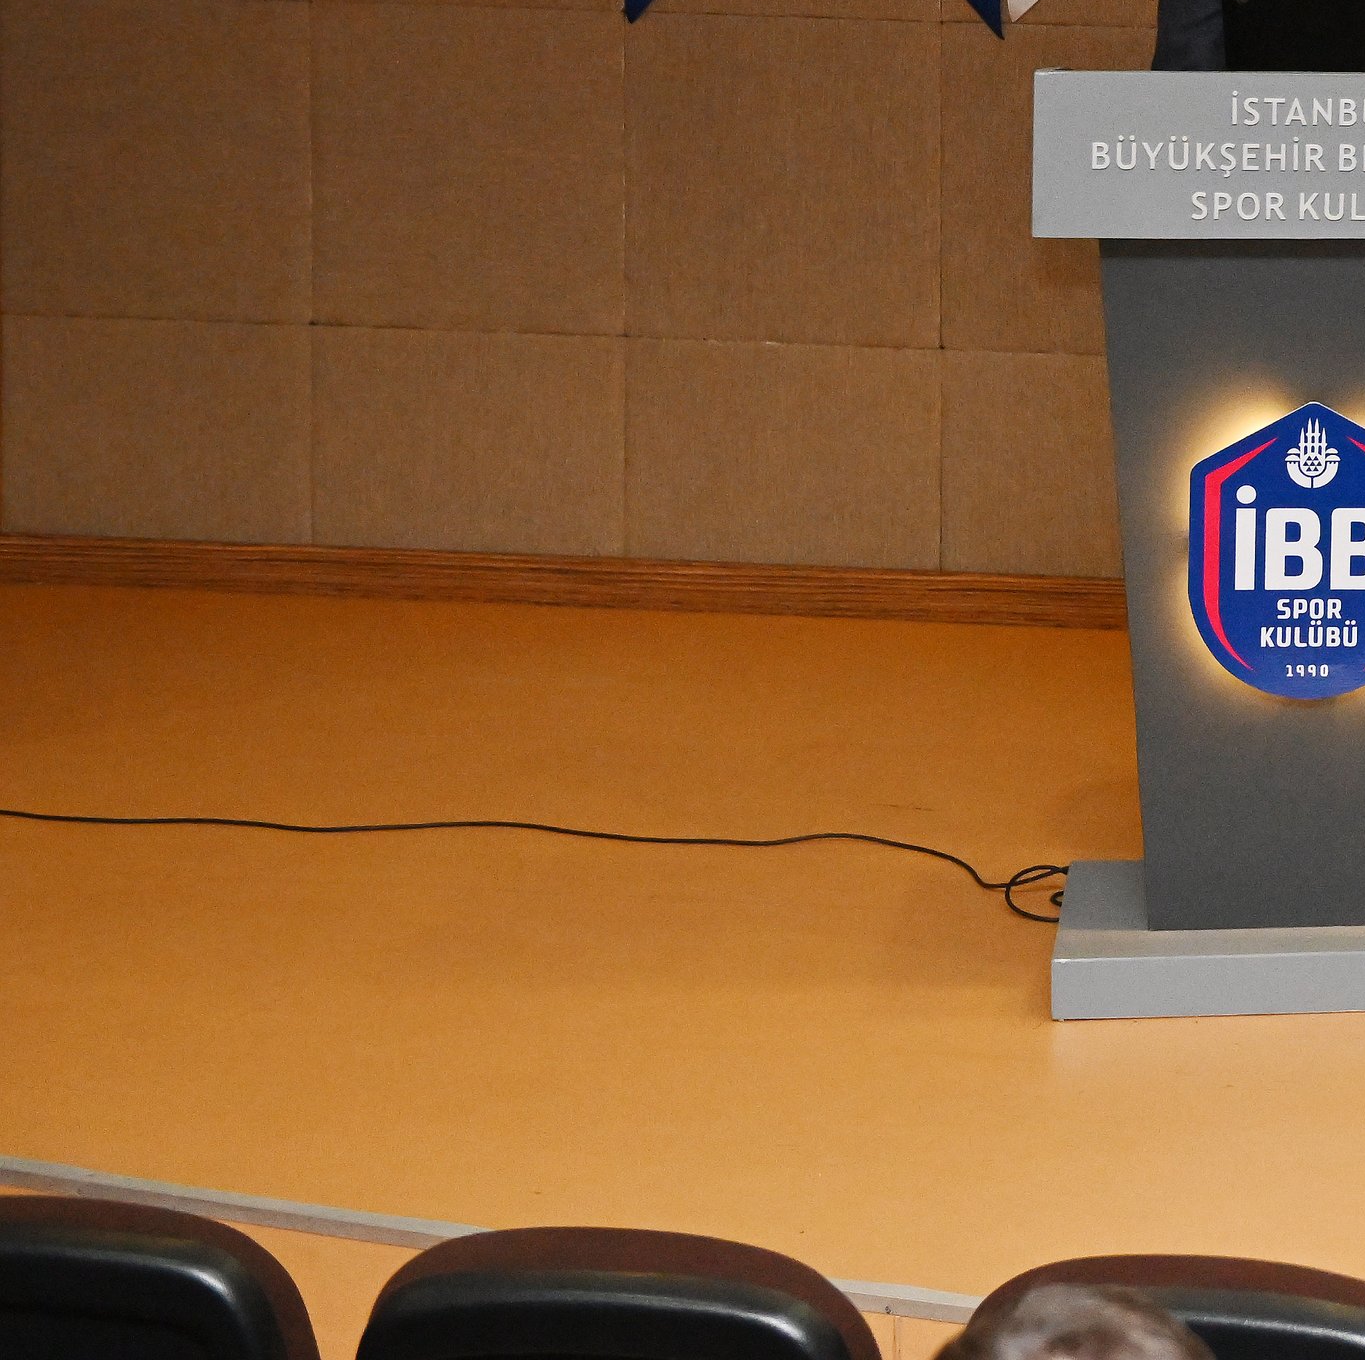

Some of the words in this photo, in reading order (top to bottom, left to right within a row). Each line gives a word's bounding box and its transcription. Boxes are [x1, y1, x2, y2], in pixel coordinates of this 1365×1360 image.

[1090, 135, 1327, 178] BÜYÜKŞEHİR
[1191, 191, 1287, 221] SPOR
[1276, 598, 1343, 620] SPOR
[1260, 619, 1358, 648] KULÜBÜ
[1285, 664, 1329, 678] 1990
